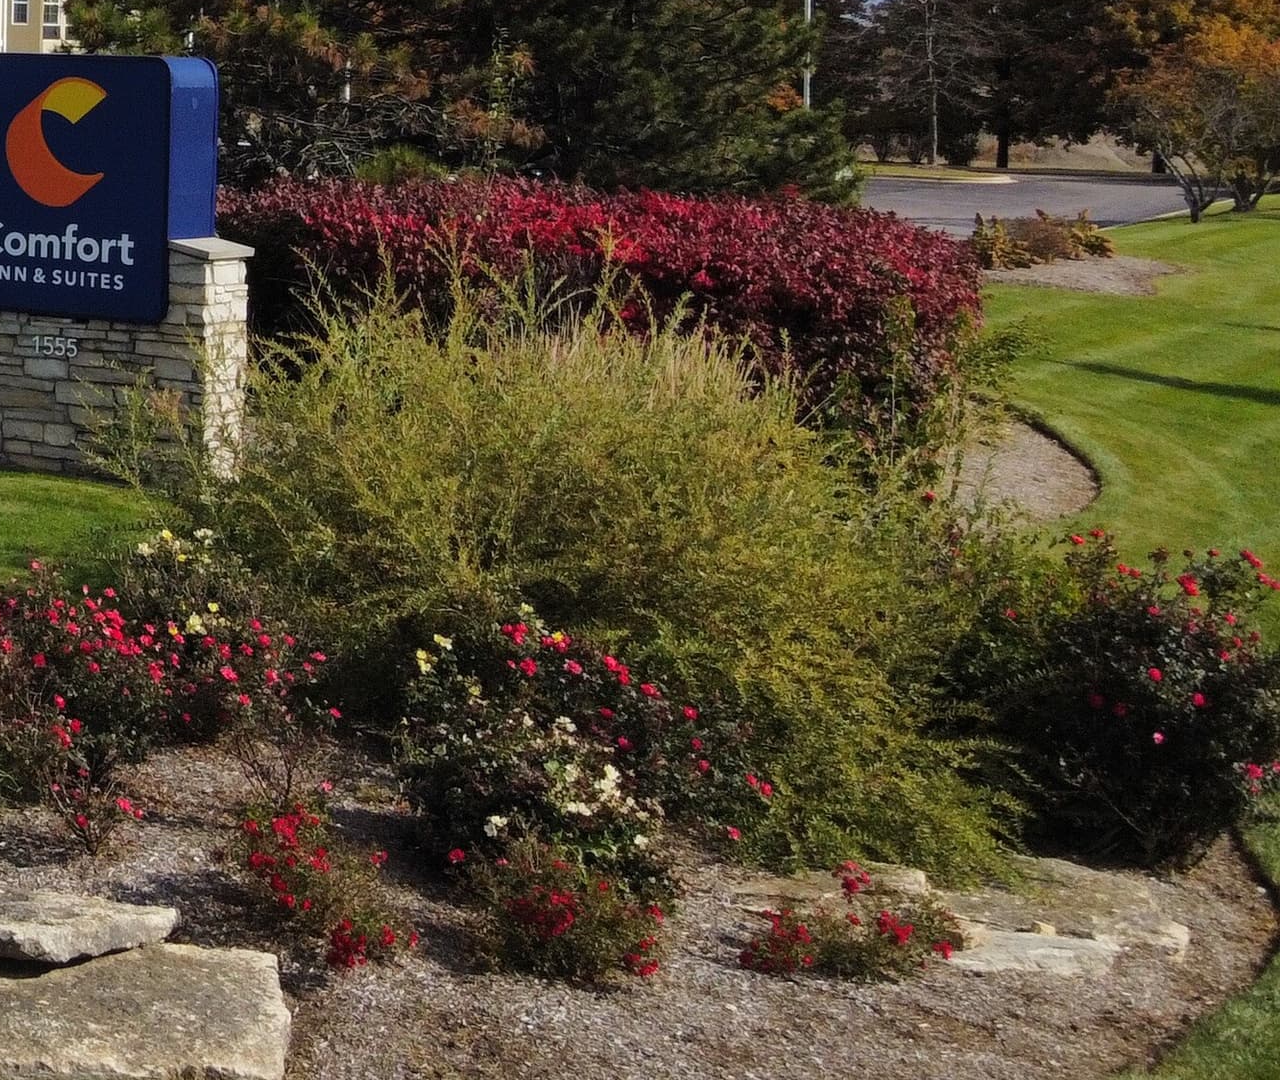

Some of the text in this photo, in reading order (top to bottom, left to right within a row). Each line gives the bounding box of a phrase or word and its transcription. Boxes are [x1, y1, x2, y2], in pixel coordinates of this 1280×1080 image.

[32, 267, 47, 285] &
[51, 269, 125, 291] SUITES
[31, 335, 79, 358] 1555
